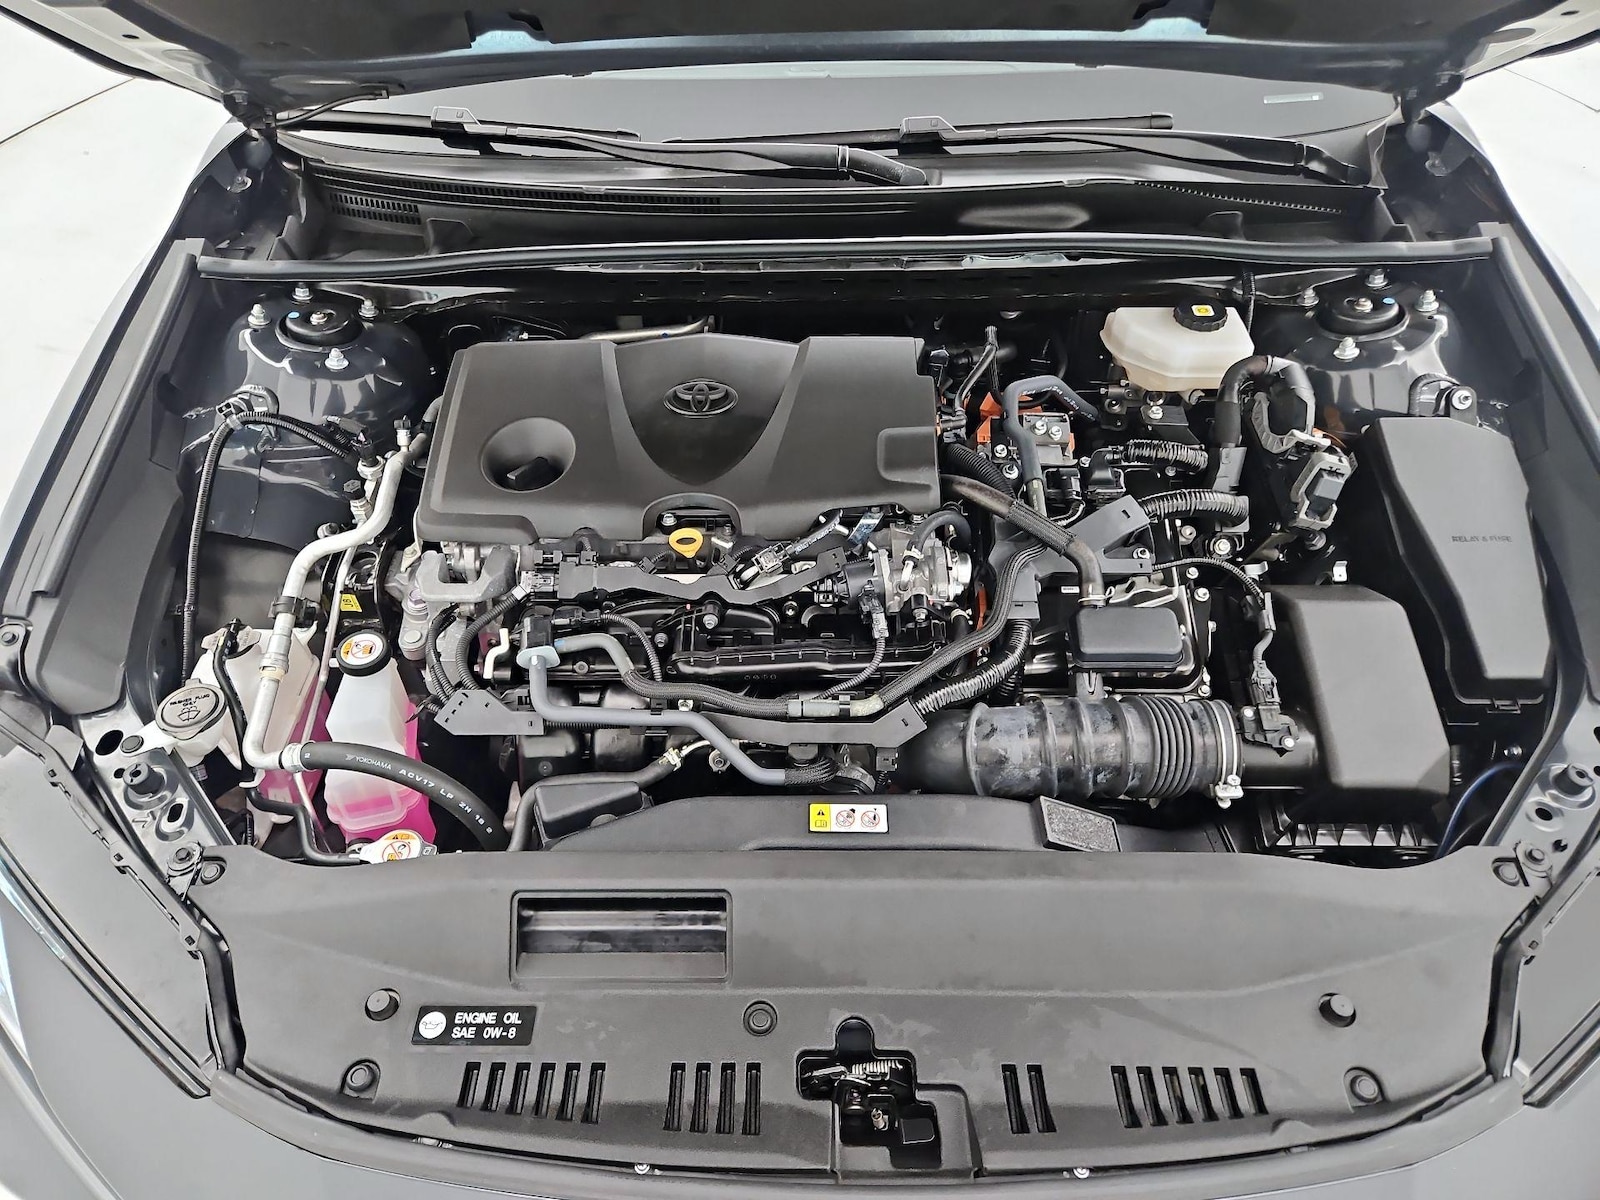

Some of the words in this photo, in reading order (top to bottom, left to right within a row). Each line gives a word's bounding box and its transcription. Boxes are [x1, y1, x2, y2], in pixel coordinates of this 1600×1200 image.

[1451, 535, 1480, 543] RELAY
[355, 756, 392, 770] YOKOHAMA
[398, 768, 435, 787] ACV17
[439, 788, 455, 800] LP
[454, 1012, 498, 1024] ENGINE
[503, 1012, 522, 1024] OIL
[451, 1026, 477, 1039] SAE
[482, 1026, 517, 1039] 0W-8
